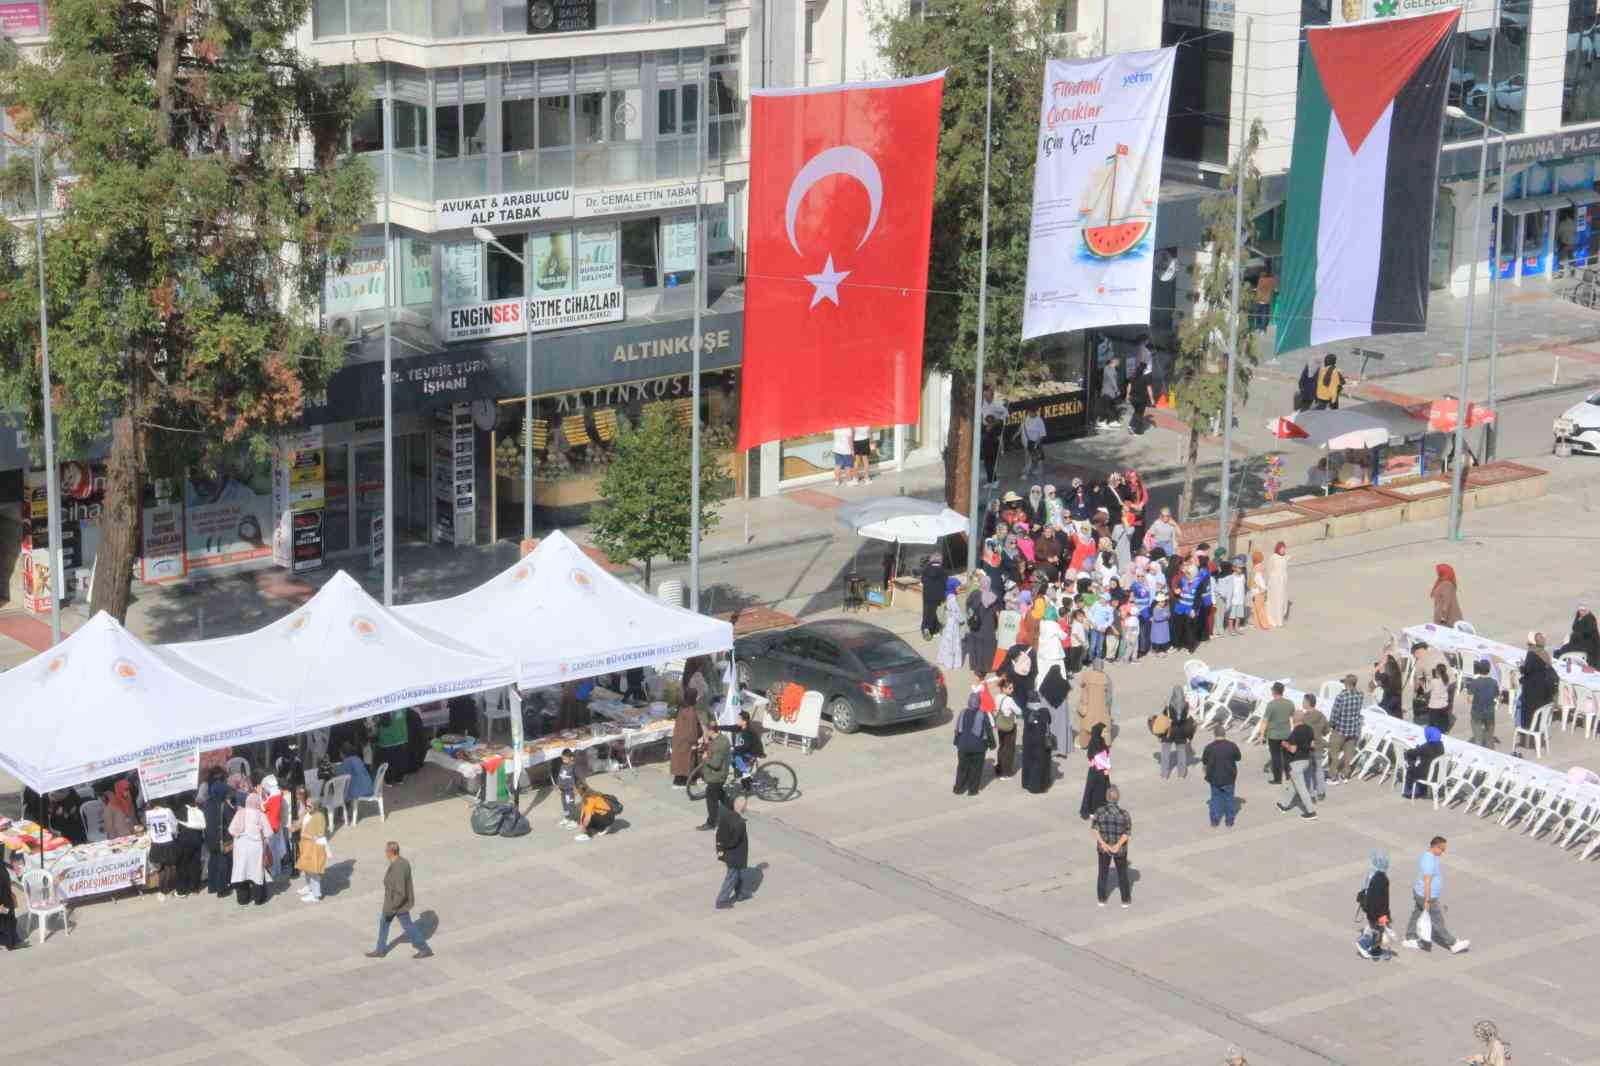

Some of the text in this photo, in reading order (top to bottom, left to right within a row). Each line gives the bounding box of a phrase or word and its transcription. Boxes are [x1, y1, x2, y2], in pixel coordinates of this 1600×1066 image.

[442, 190, 569, 212] AVUKAT & ARABULUCU
[586, 198, 599, 208] Dr.
[666, 186, 699, 198] TABAK
[470, 206, 541, 225] ALP TABAK
[152, 822, 167, 834] 15
